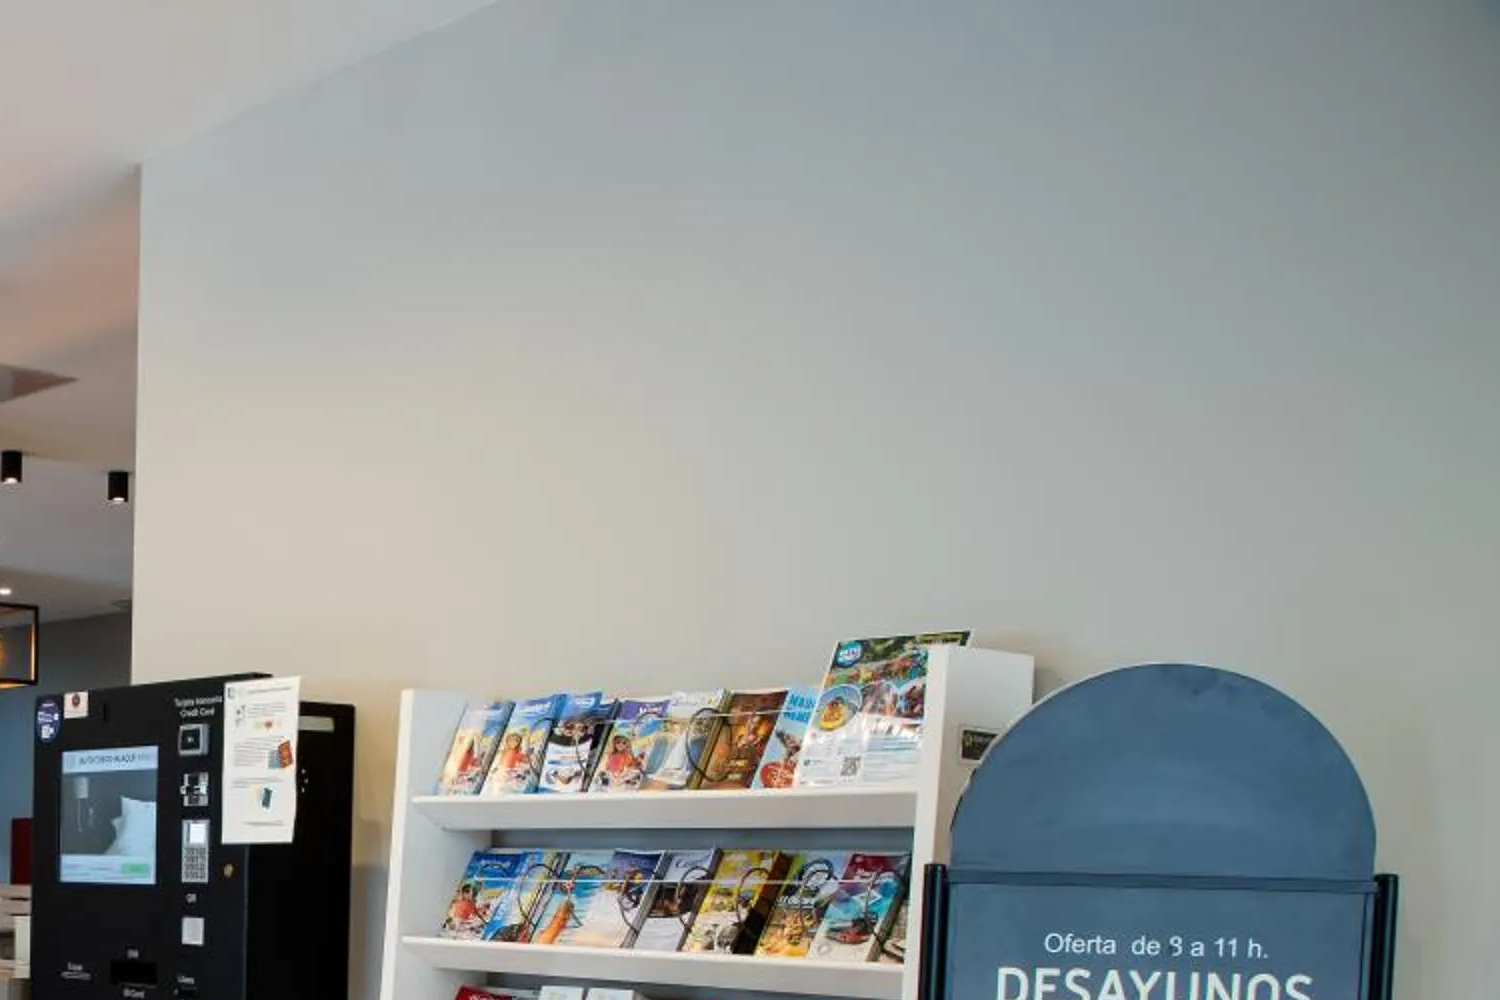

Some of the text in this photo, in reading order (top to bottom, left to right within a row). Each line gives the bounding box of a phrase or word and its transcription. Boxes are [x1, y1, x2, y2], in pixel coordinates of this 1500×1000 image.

[1043, 932, 1117, 955] Oferta
[1131, 935, 1161, 956] de
[1190, 941, 1205, 957] a
[1213, 938, 1238, 958] 11
[1247, 938, 1269, 959] h.
